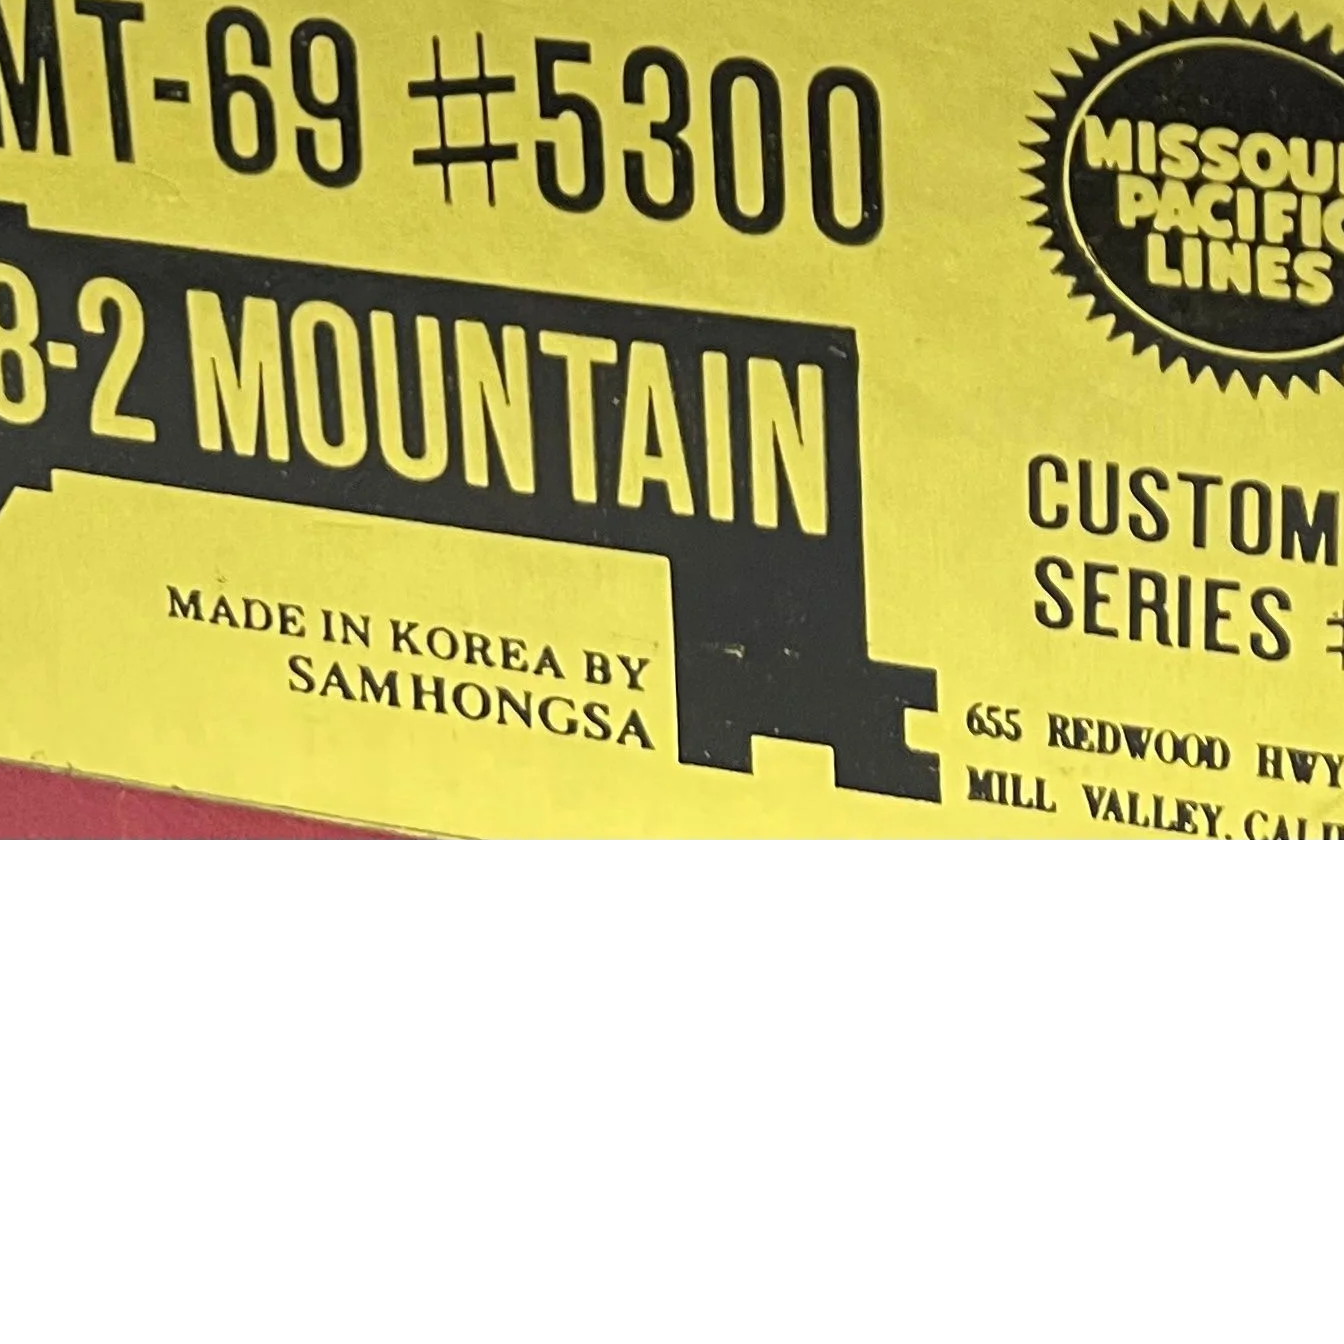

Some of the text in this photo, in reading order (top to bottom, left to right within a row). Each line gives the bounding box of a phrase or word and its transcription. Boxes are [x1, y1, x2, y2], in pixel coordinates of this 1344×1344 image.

[407, 30, 885, 246] #5300
[1145, 233, 1334, 306] LINES
[185, 288, 829, 538] MOUNTAIN
[1027, 454, 1340, 566] CUSTOM
[166, 585, 653, 692] MADE IN KOREA BY
[1034, 560, 1292, 662] SERIES
[287, 655, 656, 752] SAMHONGSA
[966, 701, 1023, 742] 655
[1047, 712, 1231, 772] REDWOOD
[966, 765, 1057, 812] MILL
